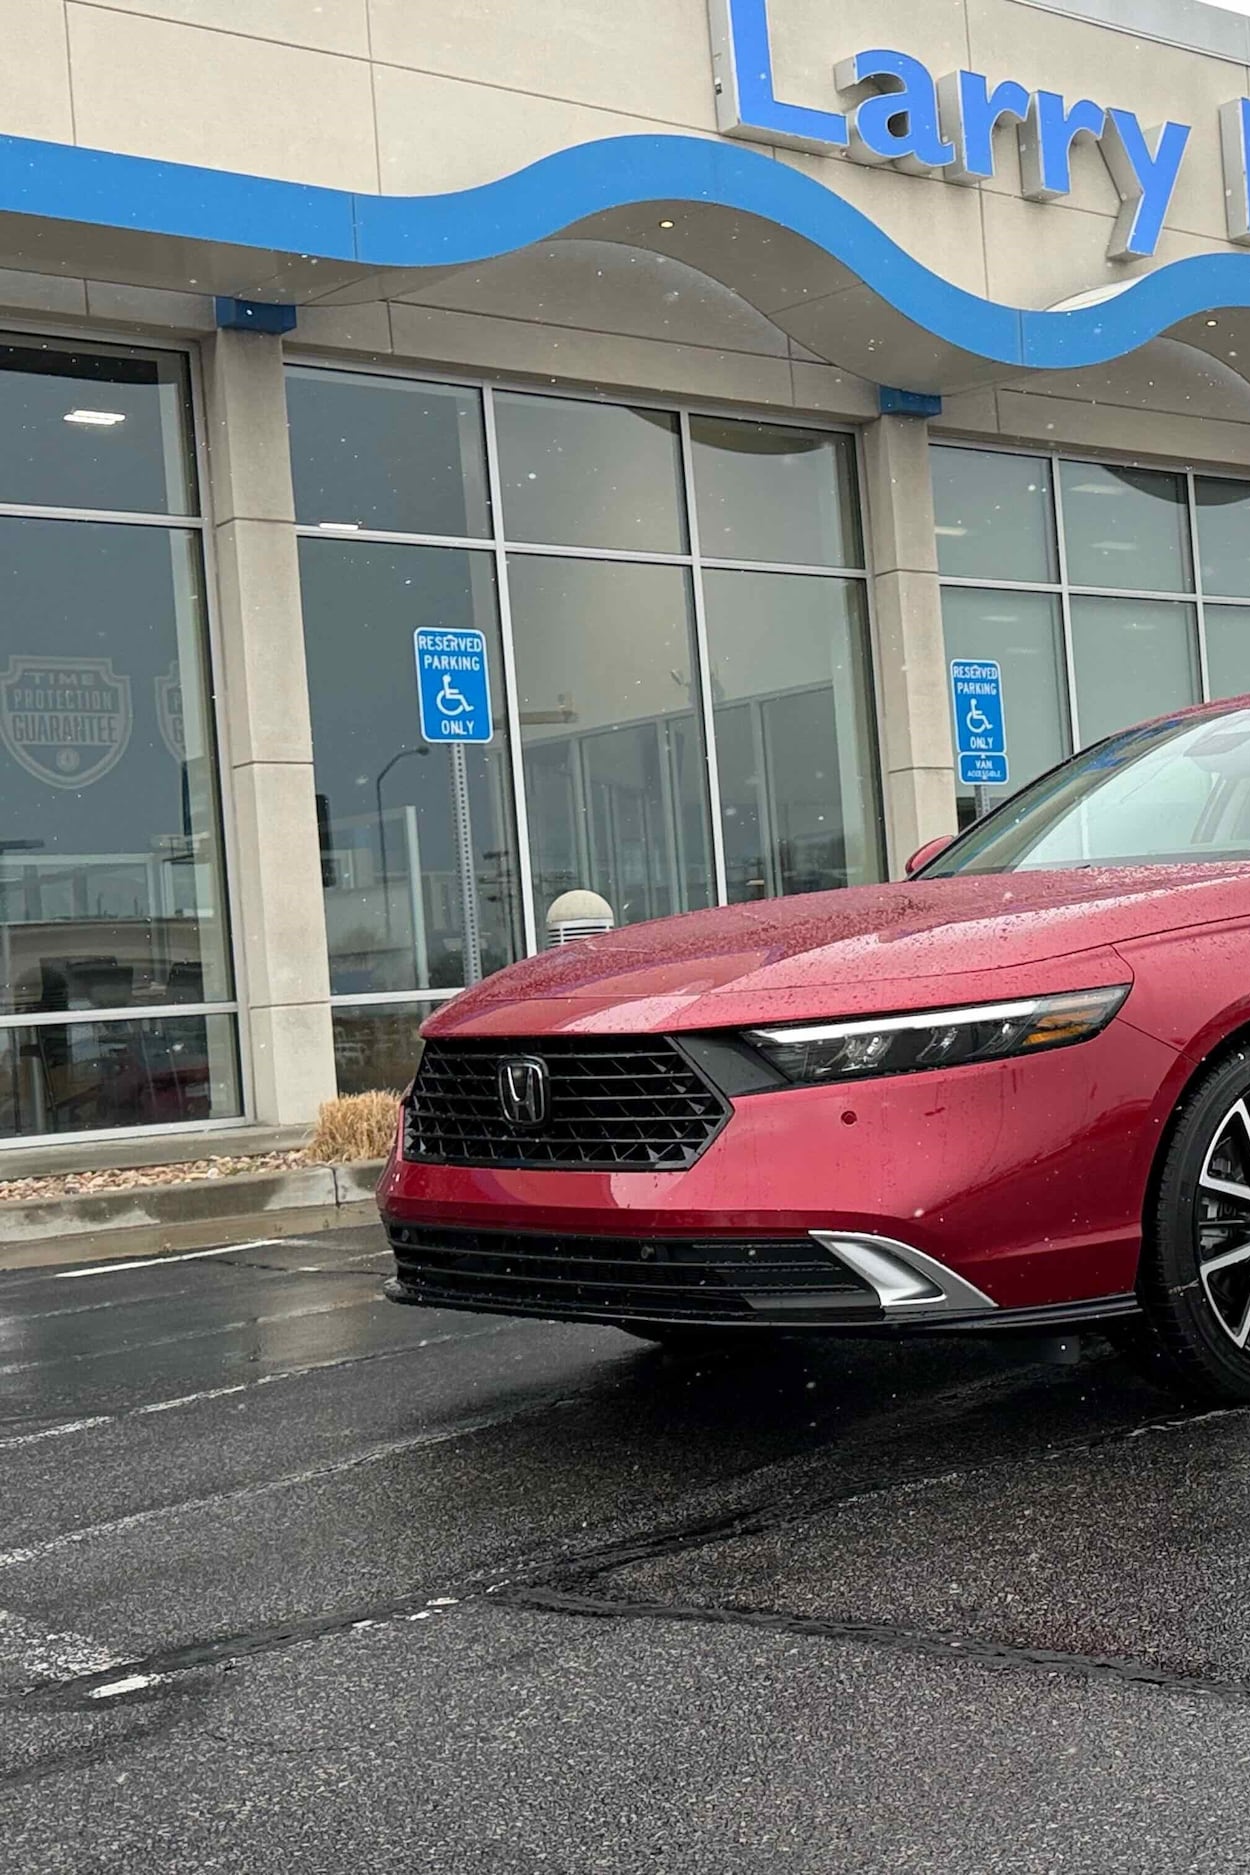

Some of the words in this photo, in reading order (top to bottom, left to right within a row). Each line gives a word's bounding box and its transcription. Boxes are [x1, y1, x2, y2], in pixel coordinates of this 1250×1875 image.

[718, 0, 1192, 258] Larry
[418, 634, 482, 653] RESERVED
[424, 654, 480, 671] PARKING
[953, 665, 998, 680] RESERVED
[957, 682, 997, 696] PARKING
[14, 688, 113, 711] PROTECTION
[12, 714, 118, 743] GUARANTEE
[441, 719, 474, 736] ONLY
[970, 735, 993, 750] ONLY
[974, 759, 993, 770] VAN
